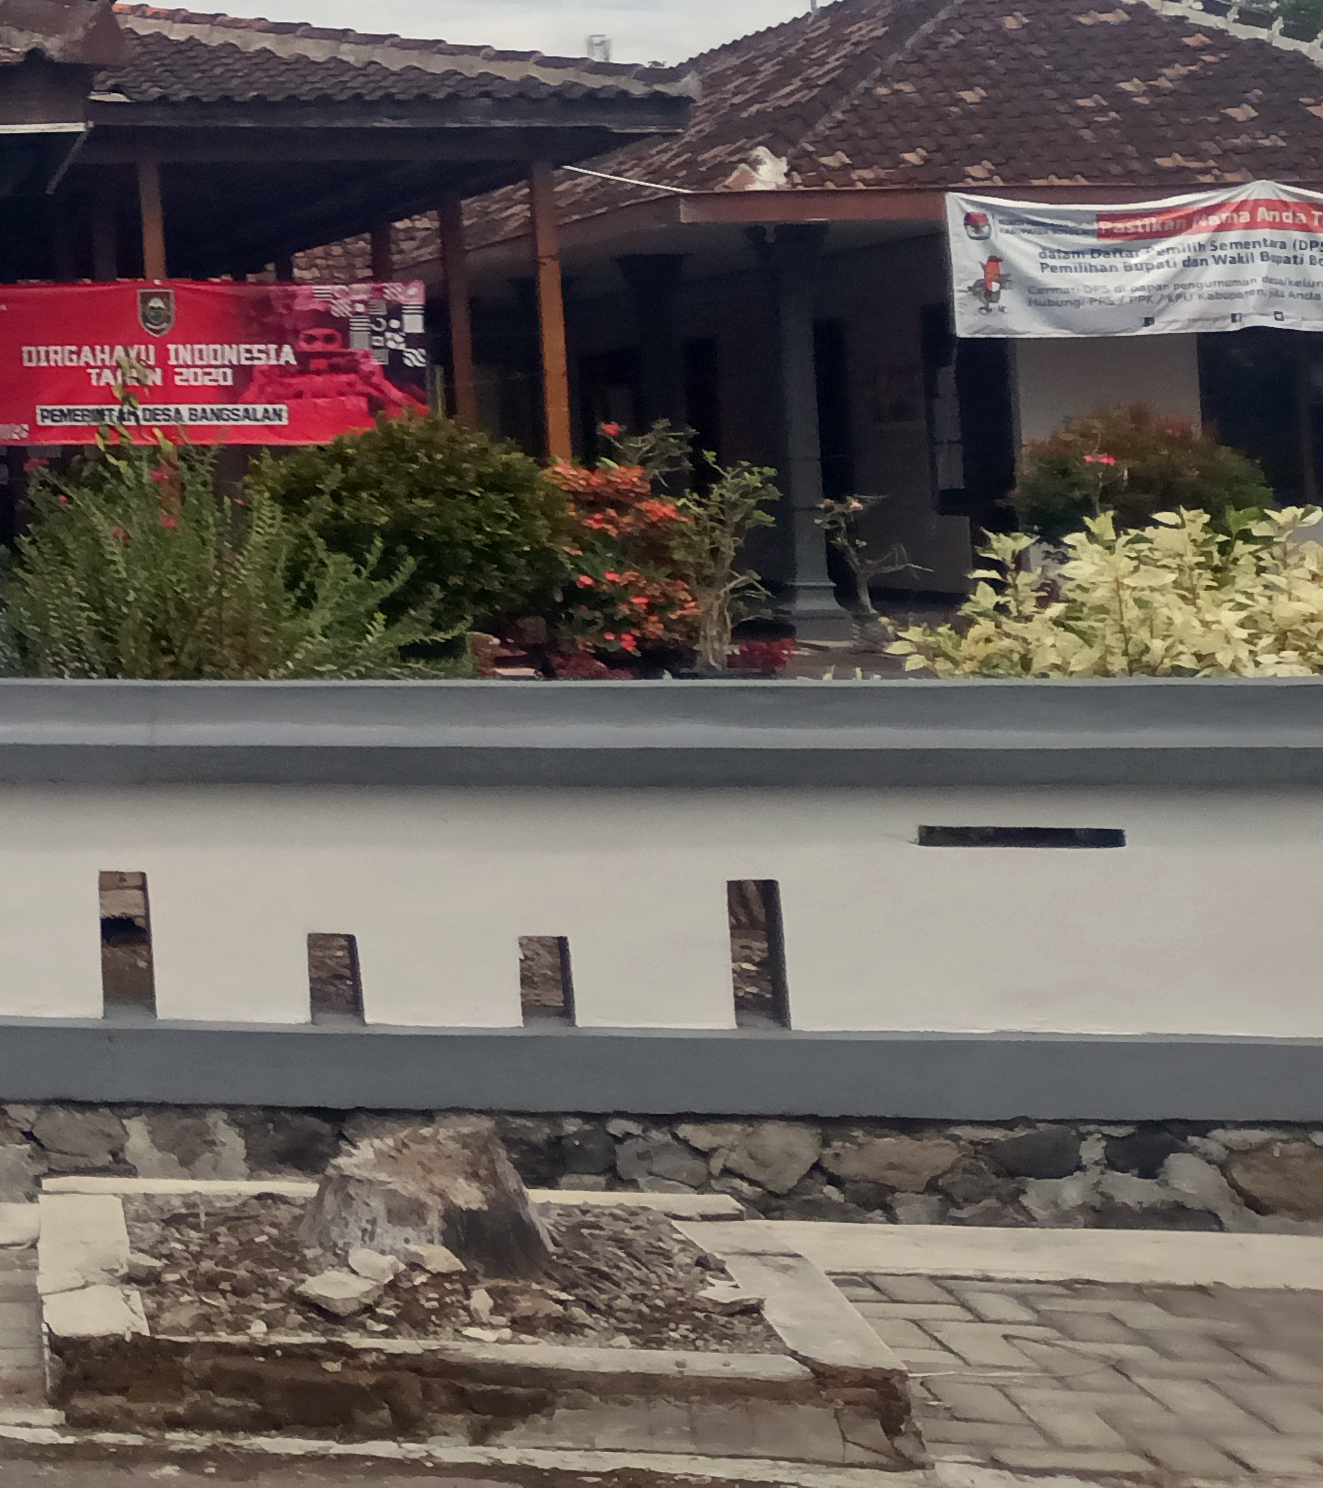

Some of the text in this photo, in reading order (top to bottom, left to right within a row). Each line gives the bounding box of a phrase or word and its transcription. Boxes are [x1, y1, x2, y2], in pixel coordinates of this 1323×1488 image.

[1193, 210, 1251, 227] Nama
[1257, 206, 1307, 224] Anda
[1040, 262, 1118, 273] Pemilihan
[1123, 258, 1177, 273] Bupati
[1182, 256, 1209, 268] dan
[1212, 252, 1254, 265] Wakil
[22, 344, 297, 367] DIRGAHAYU INDONESIA
[174, 367, 233, 386] 2020
[143, 406, 185, 423] DESA
[189, 406, 284, 423] BANGSALAN
